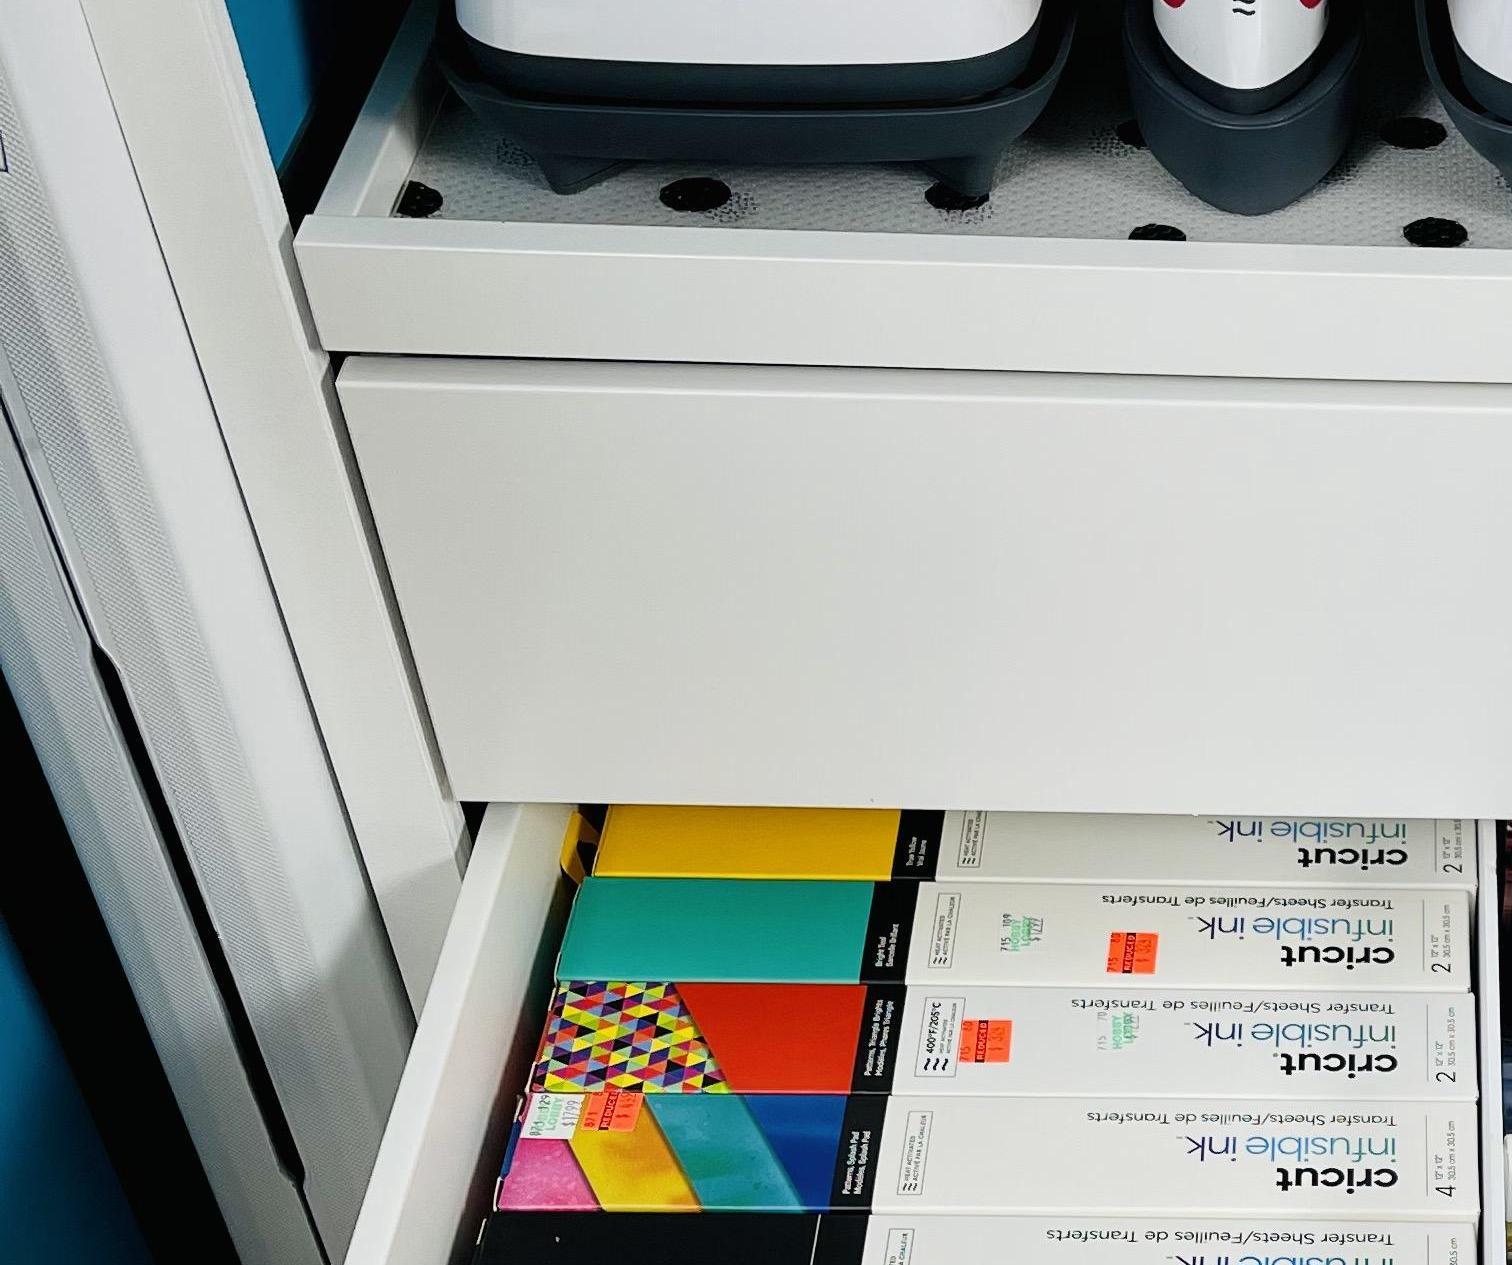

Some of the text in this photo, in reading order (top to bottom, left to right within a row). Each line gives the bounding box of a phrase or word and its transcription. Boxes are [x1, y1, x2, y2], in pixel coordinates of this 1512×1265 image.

[1270, 819, 1407, 845] infusible
[1297, 847, 1409, 871] cricut
[1443, 863, 1463, 873] 2
[1101, 894, 1394, 910] Transfer Sheets/Feuilles de Transferts
[1252, 916, 1394, 942] infusible
[1280, 945, 1395, 970] cricut
[1432, 963, 1451, 973] 2
[1072, 998, 1395, 1014] Transfer Sheets/Feuilles de Transferts
[925, 1002, 942, 1054] 400°F/205°C
[1250, 1023, 1396, 1050] infusible
[975, 1022, 988, 1061] REDUCED
[1280, 1053, 1398, 1079] cricut
[1435, 1071, 1456, 1083] 2
[1087, 1111, 1397, 1126] Transfer Sheets/Feuilles de Transferts
[1246, 1136, 1396, 1164] infusible
[1276, 1167, 1399, 1195] cricut
[1435, 1185, 1457, 1198] 4
[1046, 1229, 1395, 1246] Transfer Sheets/Feuilles de Transferts
